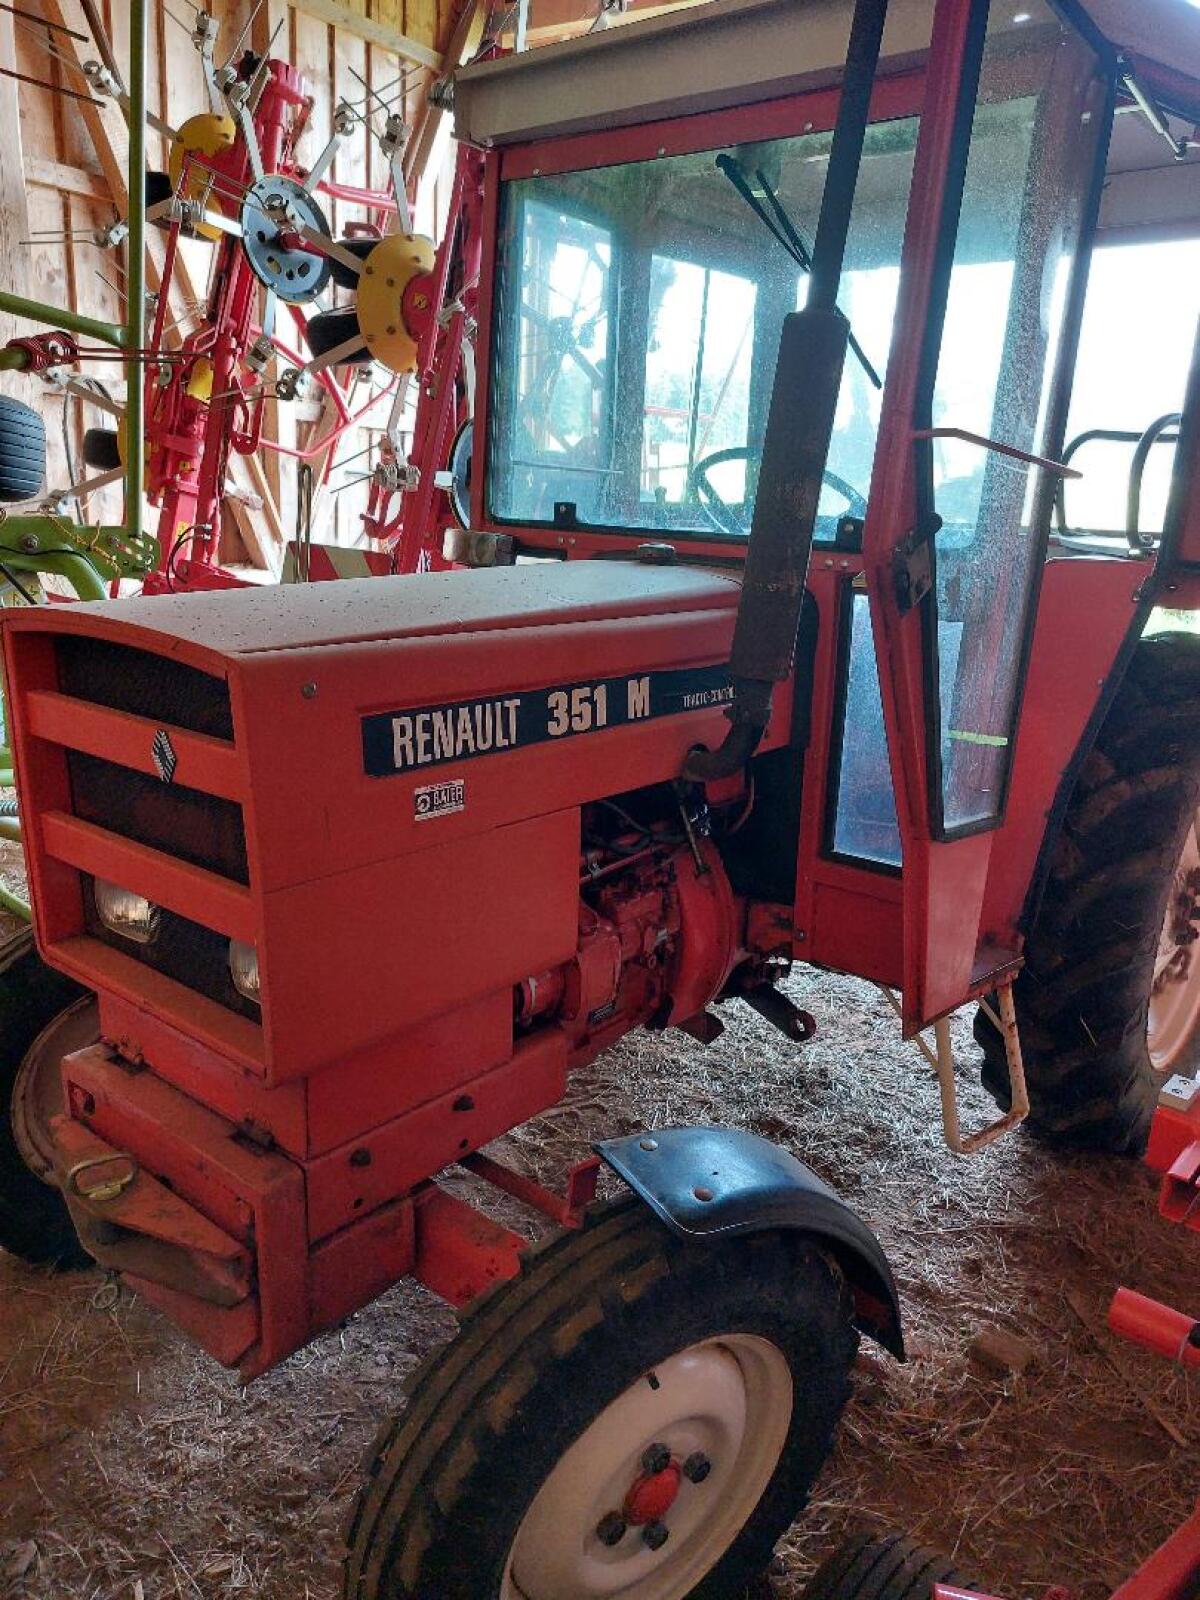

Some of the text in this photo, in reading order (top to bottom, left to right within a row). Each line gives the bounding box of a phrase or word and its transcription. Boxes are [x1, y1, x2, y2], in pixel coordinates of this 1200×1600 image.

[392, 677, 650, 768] RENAULT 351 M
